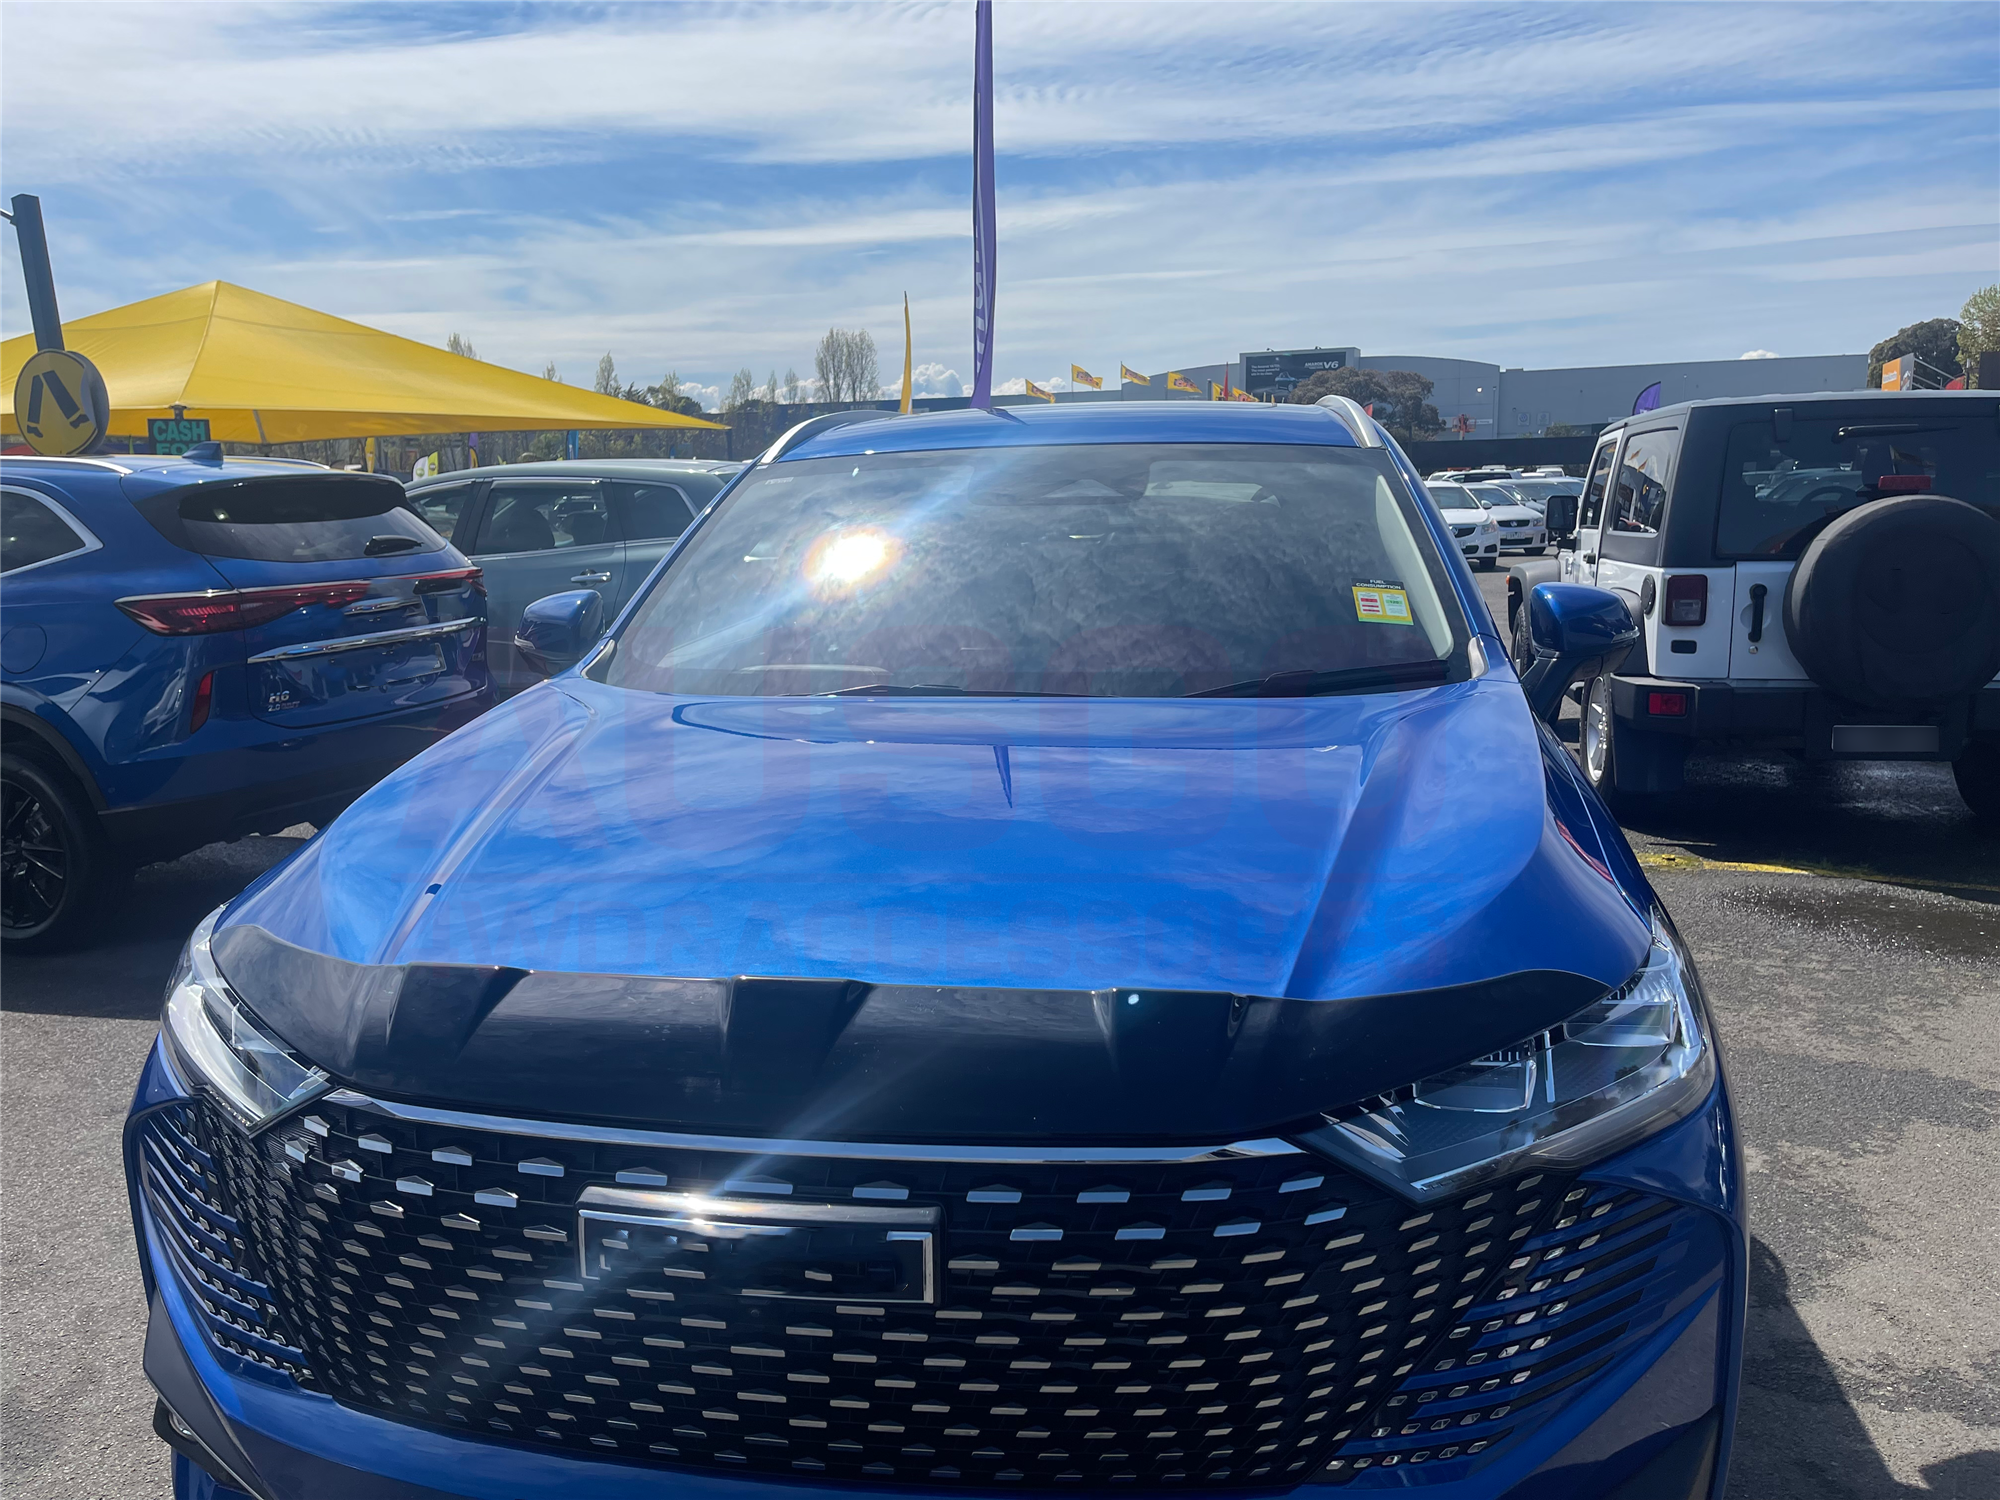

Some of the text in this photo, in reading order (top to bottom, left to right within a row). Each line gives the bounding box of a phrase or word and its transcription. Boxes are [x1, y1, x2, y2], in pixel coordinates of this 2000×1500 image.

[1323, 361, 1339, 369] V6
[153, 420, 206, 441] CASH
[156, 442, 202, 455] FO
[269, 691, 290, 703] H6
